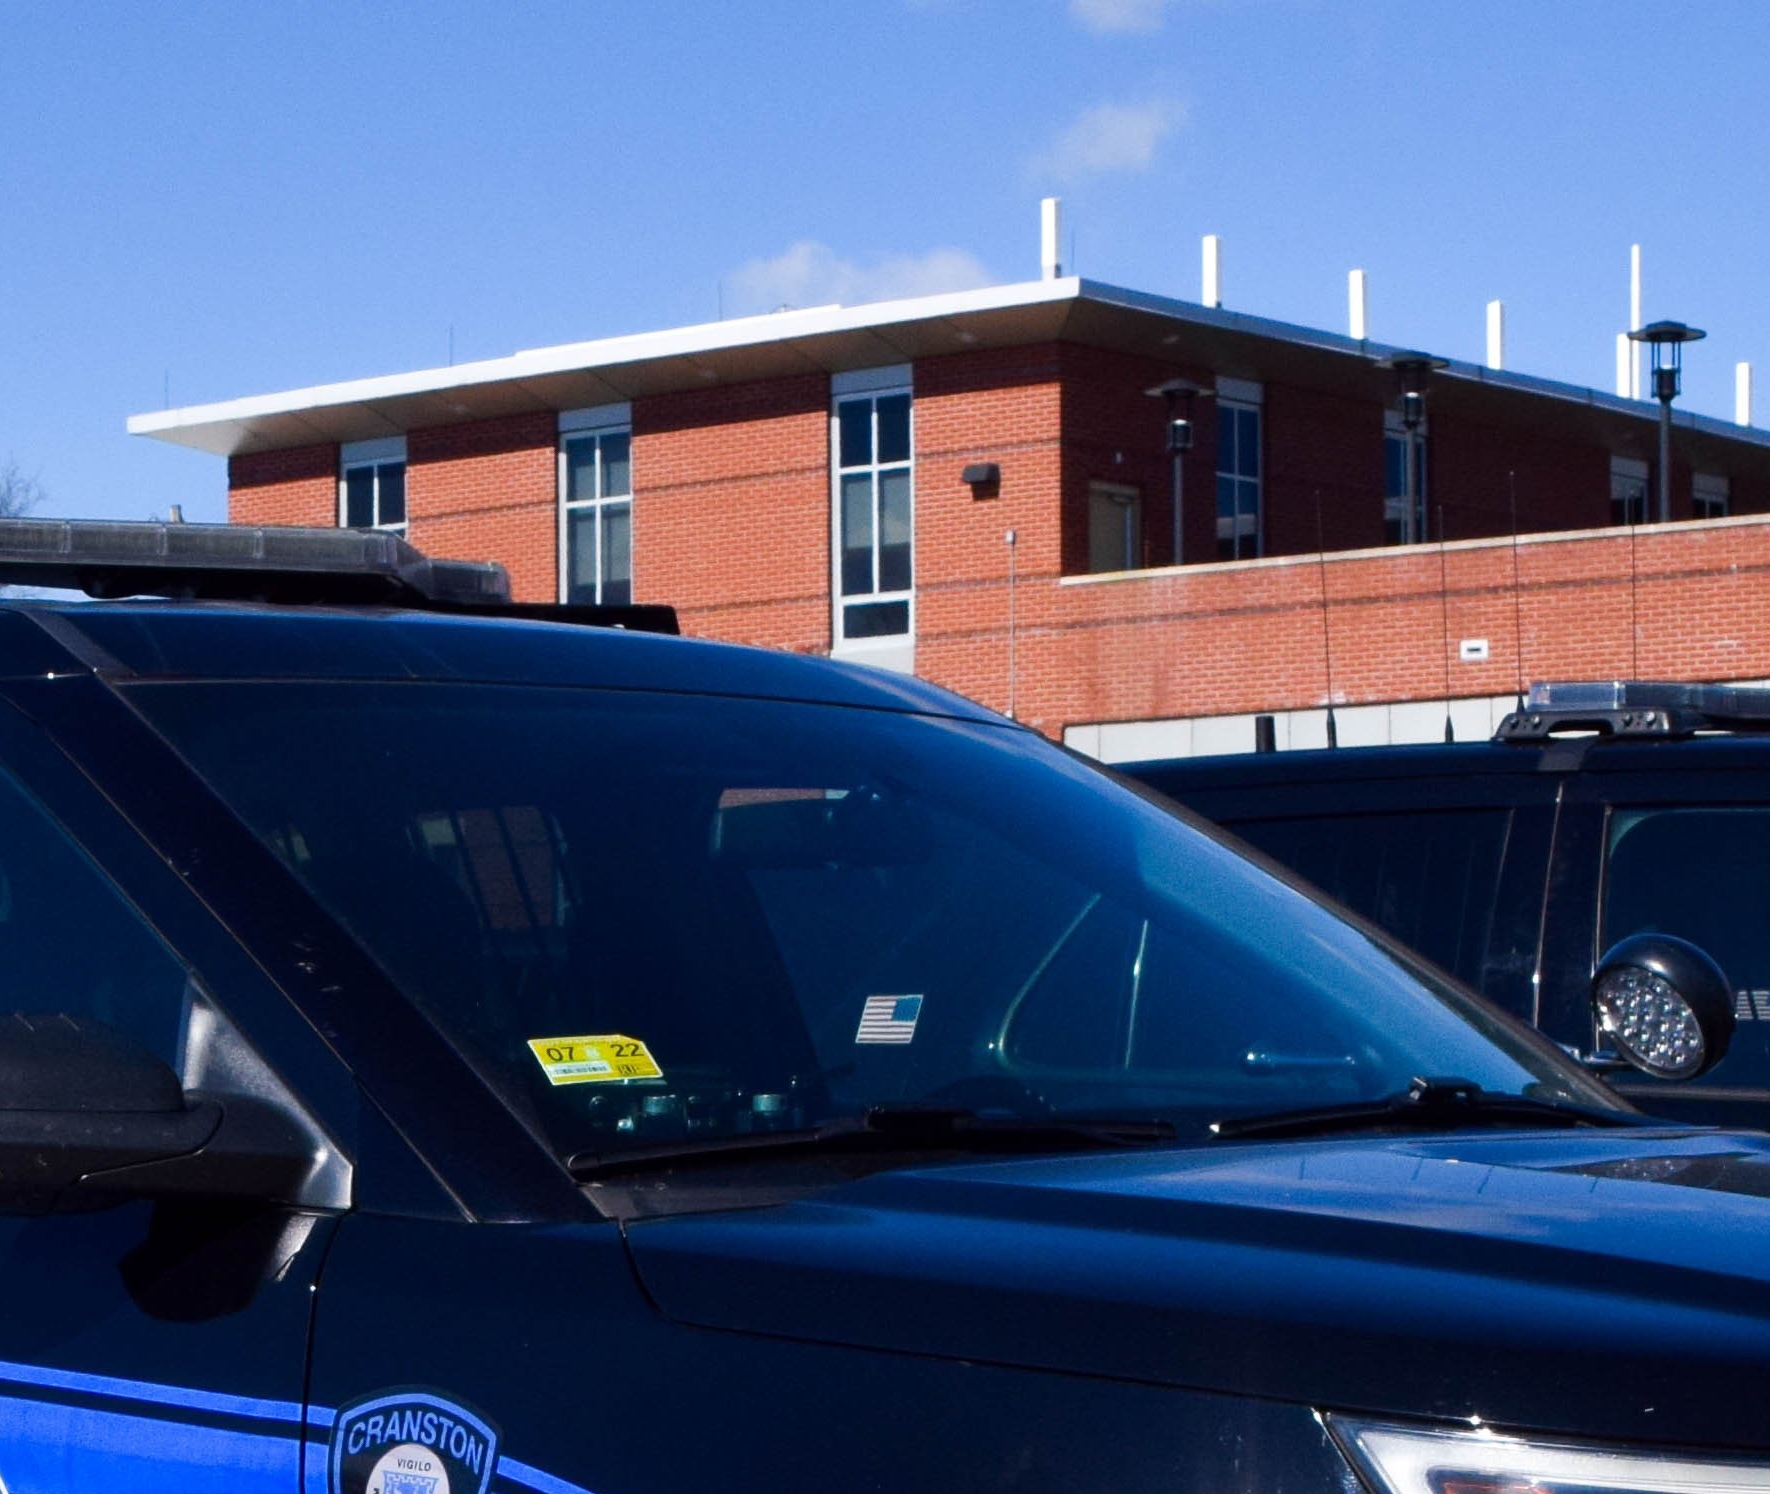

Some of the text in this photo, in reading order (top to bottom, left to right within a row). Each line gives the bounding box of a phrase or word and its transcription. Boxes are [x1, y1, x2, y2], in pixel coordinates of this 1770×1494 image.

[546, 1043, 645, 1062] 07 22
[348, 1411, 483, 1474] CRANSTON
[397, 1459, 432, 1472] VIGILO
